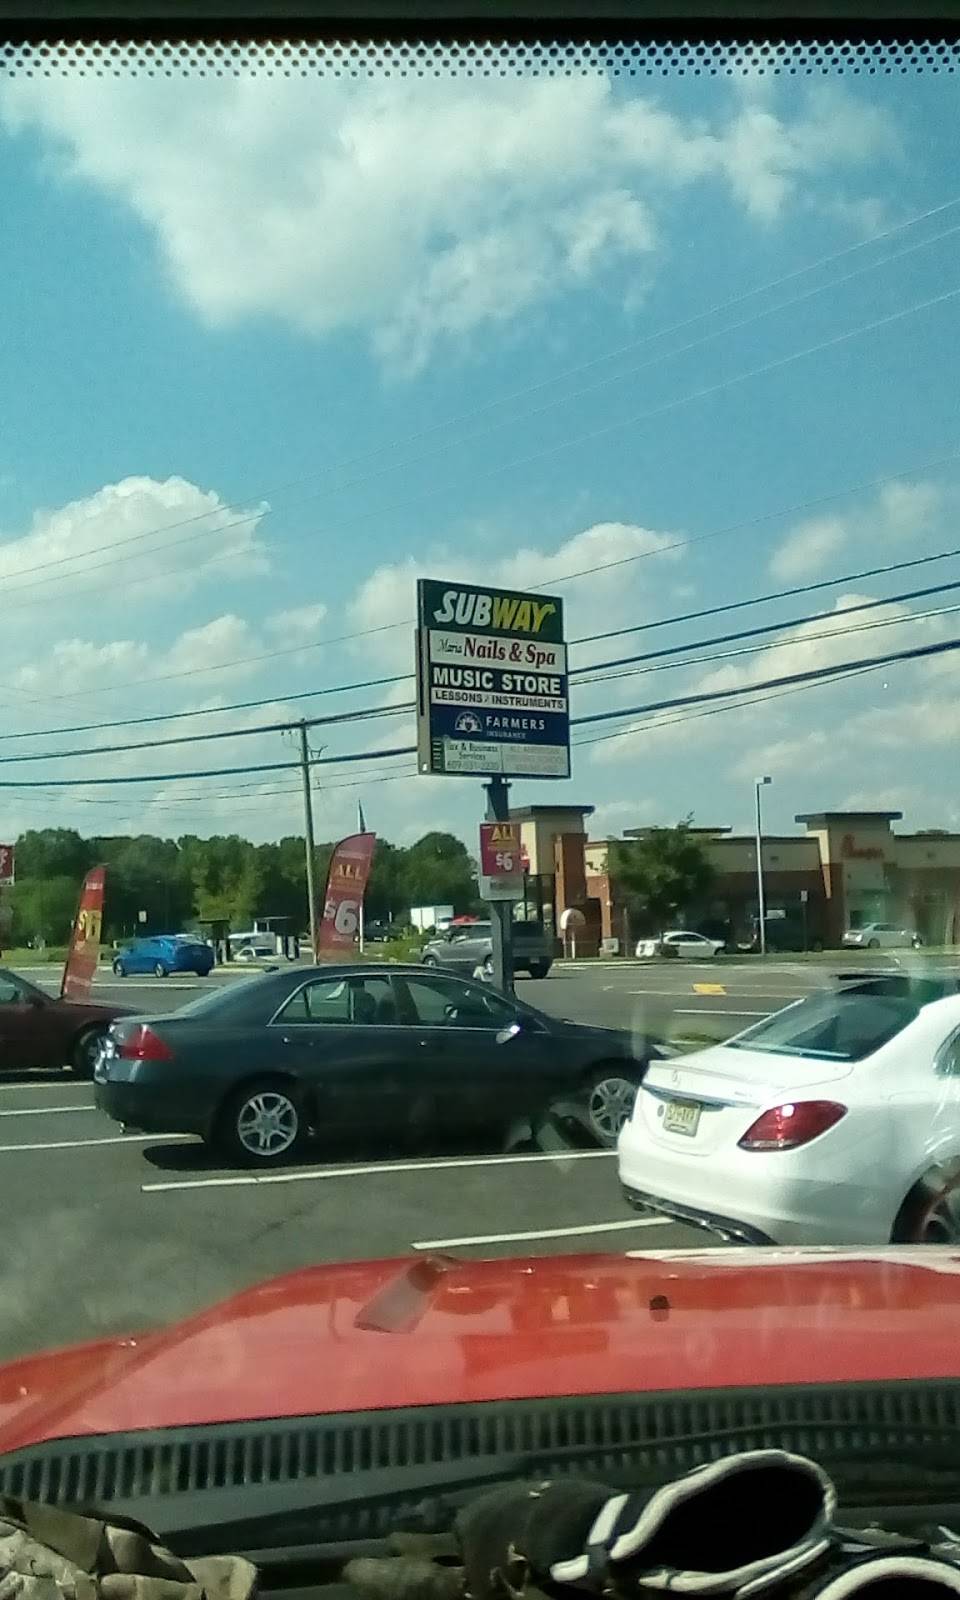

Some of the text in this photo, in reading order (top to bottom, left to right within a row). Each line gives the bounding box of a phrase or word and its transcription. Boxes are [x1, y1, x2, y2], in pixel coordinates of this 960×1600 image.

[433, 590, 556, 632] SUBWAY
[464, 637, 506, 660] Nails
[509, 642, 522, 662] &
[525, 644, 556, 668] Spa
[433, 667, 561, 694] MUSIC STORE
[435, 690, 482, 703] LESSONS
[491, 694, 564, 709] INSTRUMENTS
[486, 715, 545, 730] FARMERS
[486, 731, 526, 739] INSURANCE
[331, 863, 362, 880] ALL
[323, 898, 359, 935] $6
